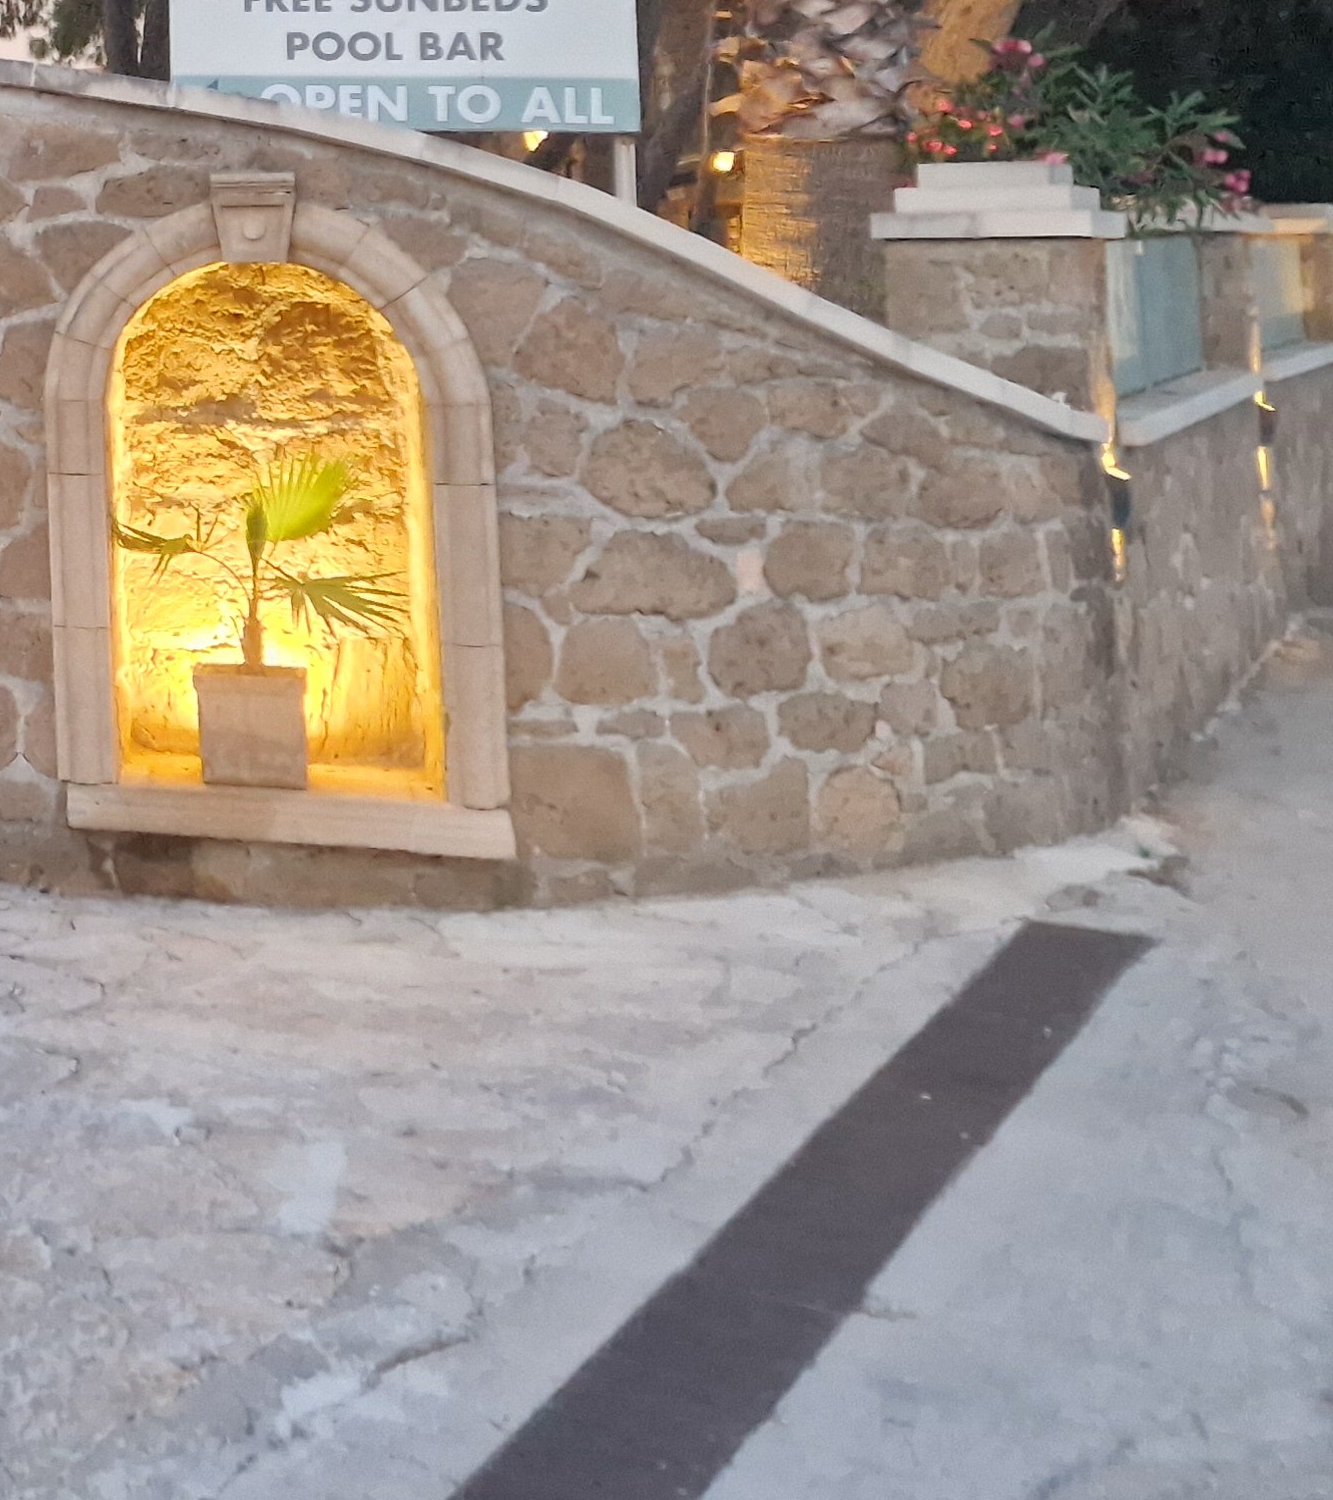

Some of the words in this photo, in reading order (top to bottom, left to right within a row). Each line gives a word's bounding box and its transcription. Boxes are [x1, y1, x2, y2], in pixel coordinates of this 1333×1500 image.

[286, 31, 403, 61] POOL
[419, 31, 505, 61] BAR
[428, 85, 502, 124] TO
[520, 86, 615, 124] ALL
